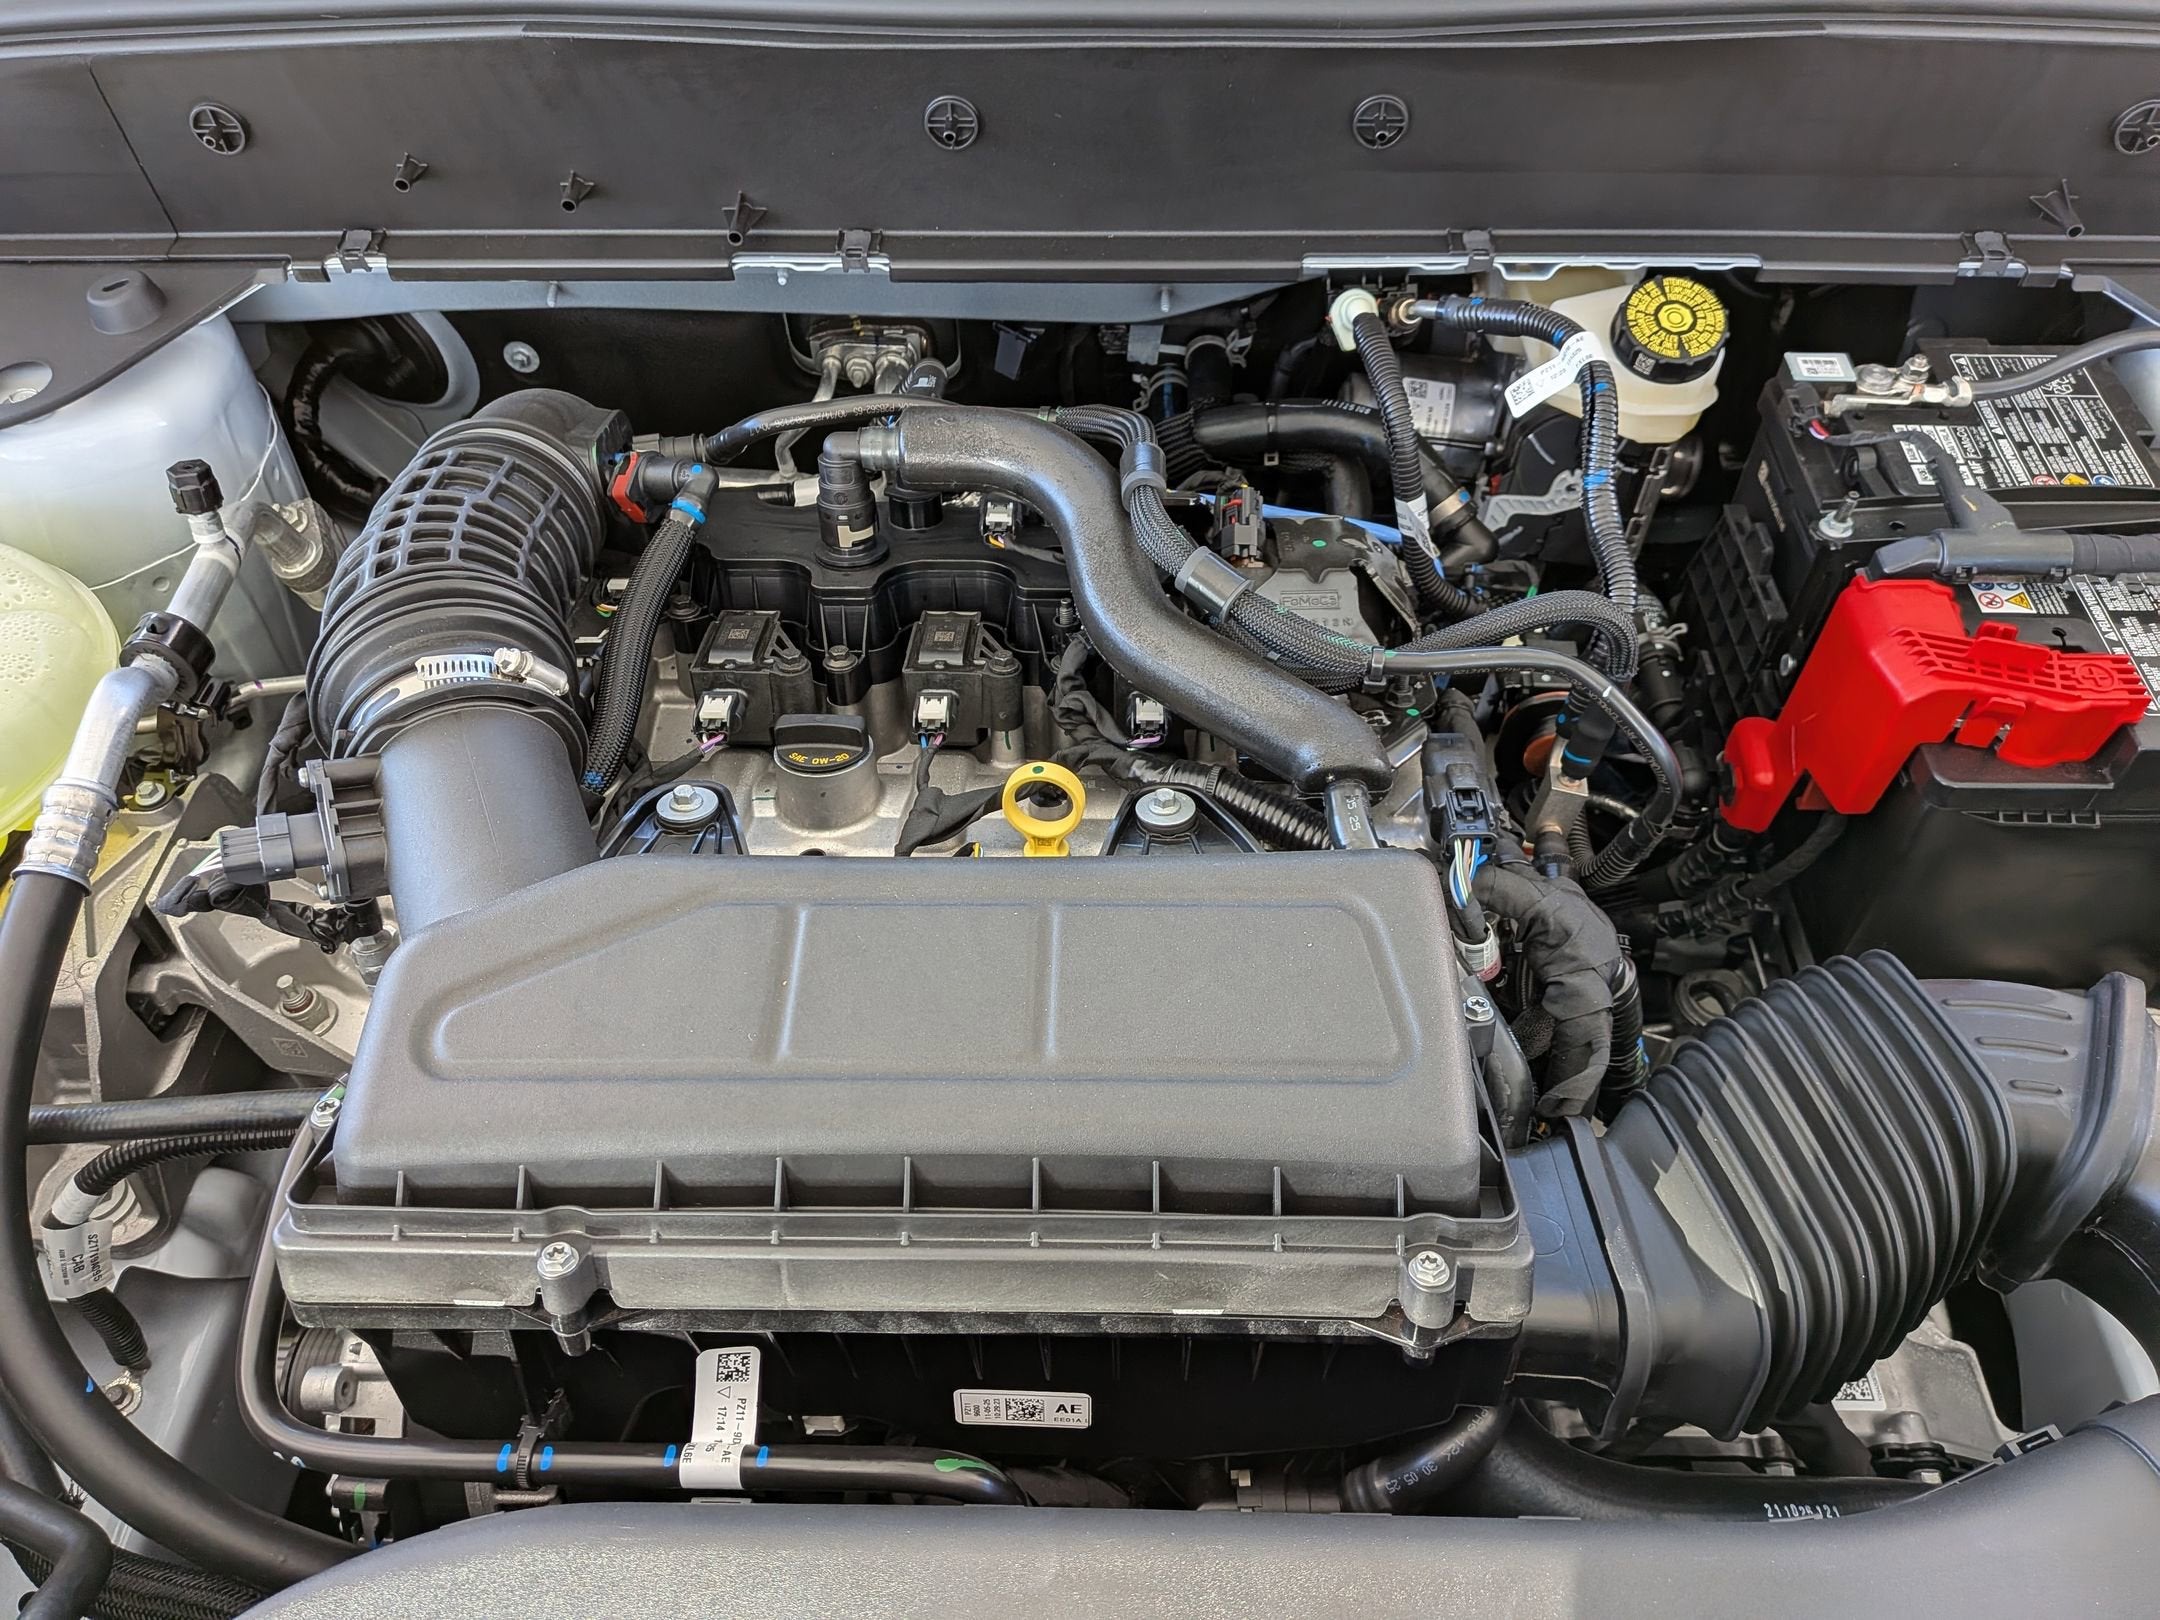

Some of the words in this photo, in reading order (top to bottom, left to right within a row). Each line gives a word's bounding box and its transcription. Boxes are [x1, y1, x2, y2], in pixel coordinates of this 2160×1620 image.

[789, 752, 808, 763] SAE
[811, 753, 850, 765] 0W-20
[71, 1253, 85, 1274] CAB
[1055, 1403, 1083, 1415] AE
[716, 1406, 728, 1431] 17:14
